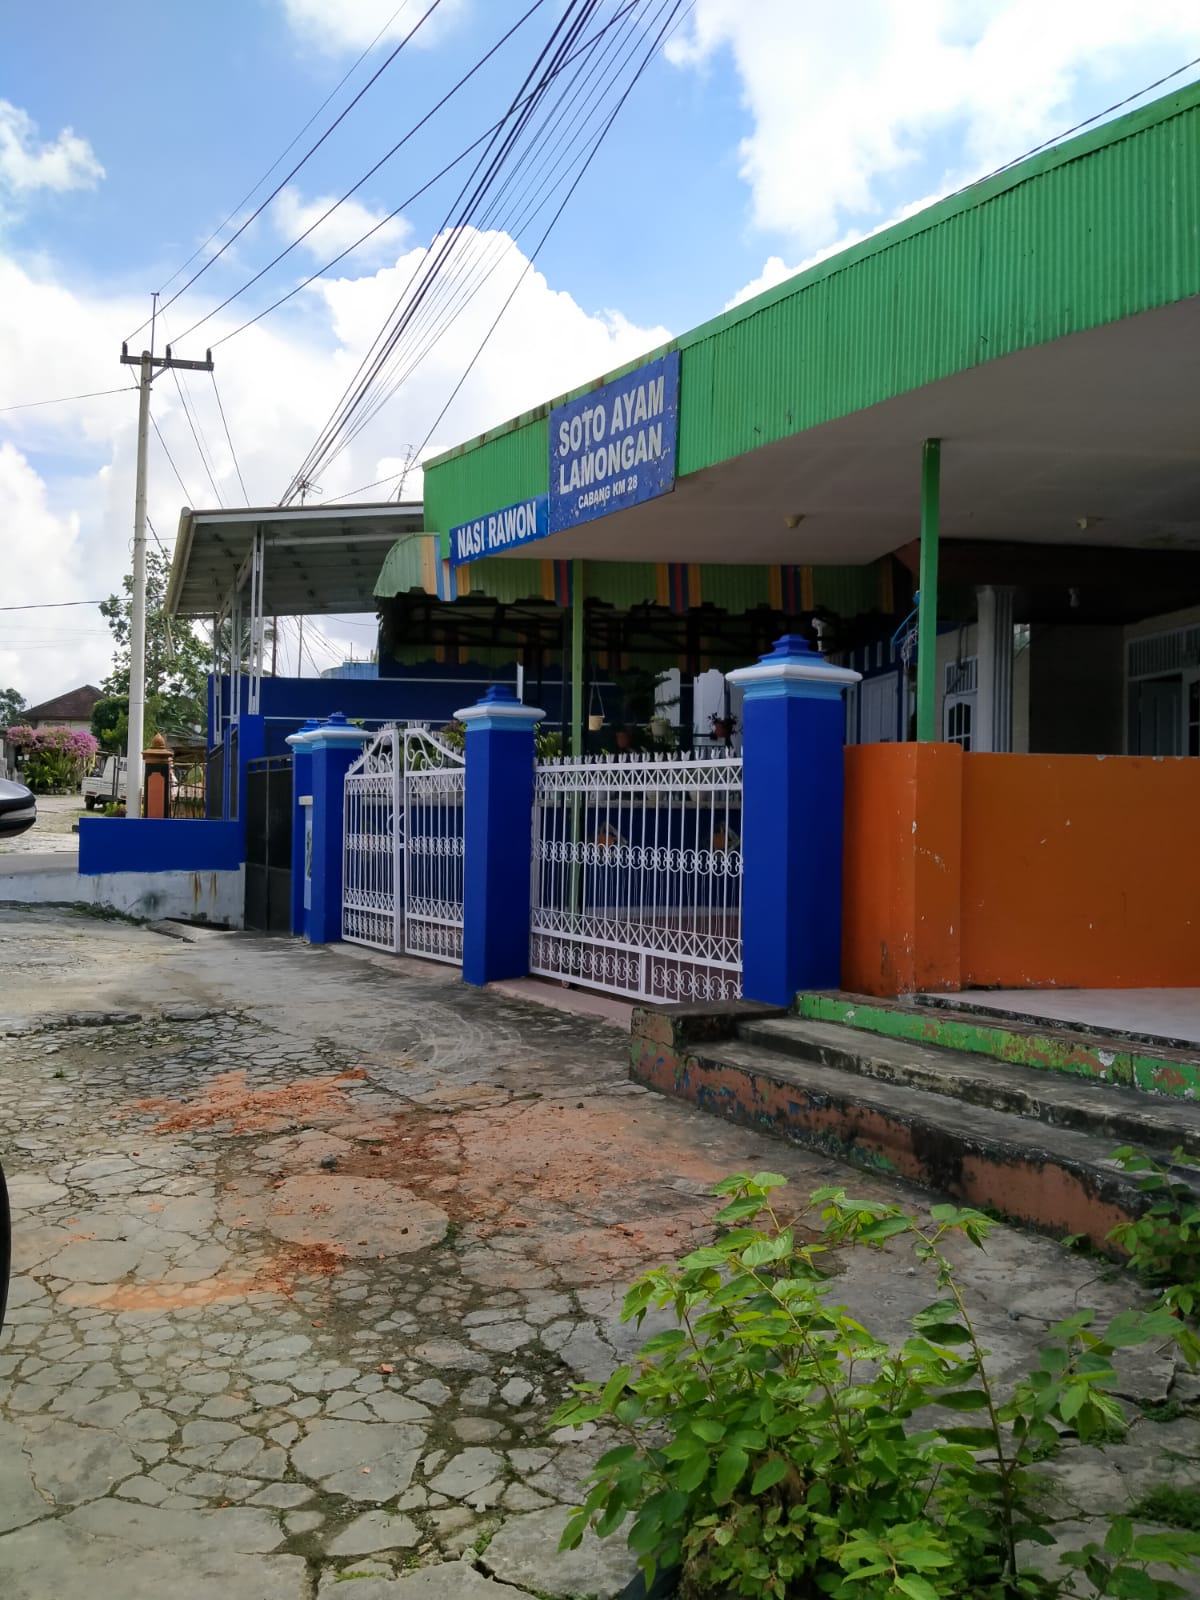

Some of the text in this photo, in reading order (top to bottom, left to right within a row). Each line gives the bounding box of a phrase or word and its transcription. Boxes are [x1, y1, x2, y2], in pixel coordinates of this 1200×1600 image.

[559, 376, 664, 457] SOTO AYAM
[560, 423, 662, 494] LAMONGAN
[578, 475, 638, 508] CABANG KM 28
[457, 502, 537, 559] NASI RAWON
